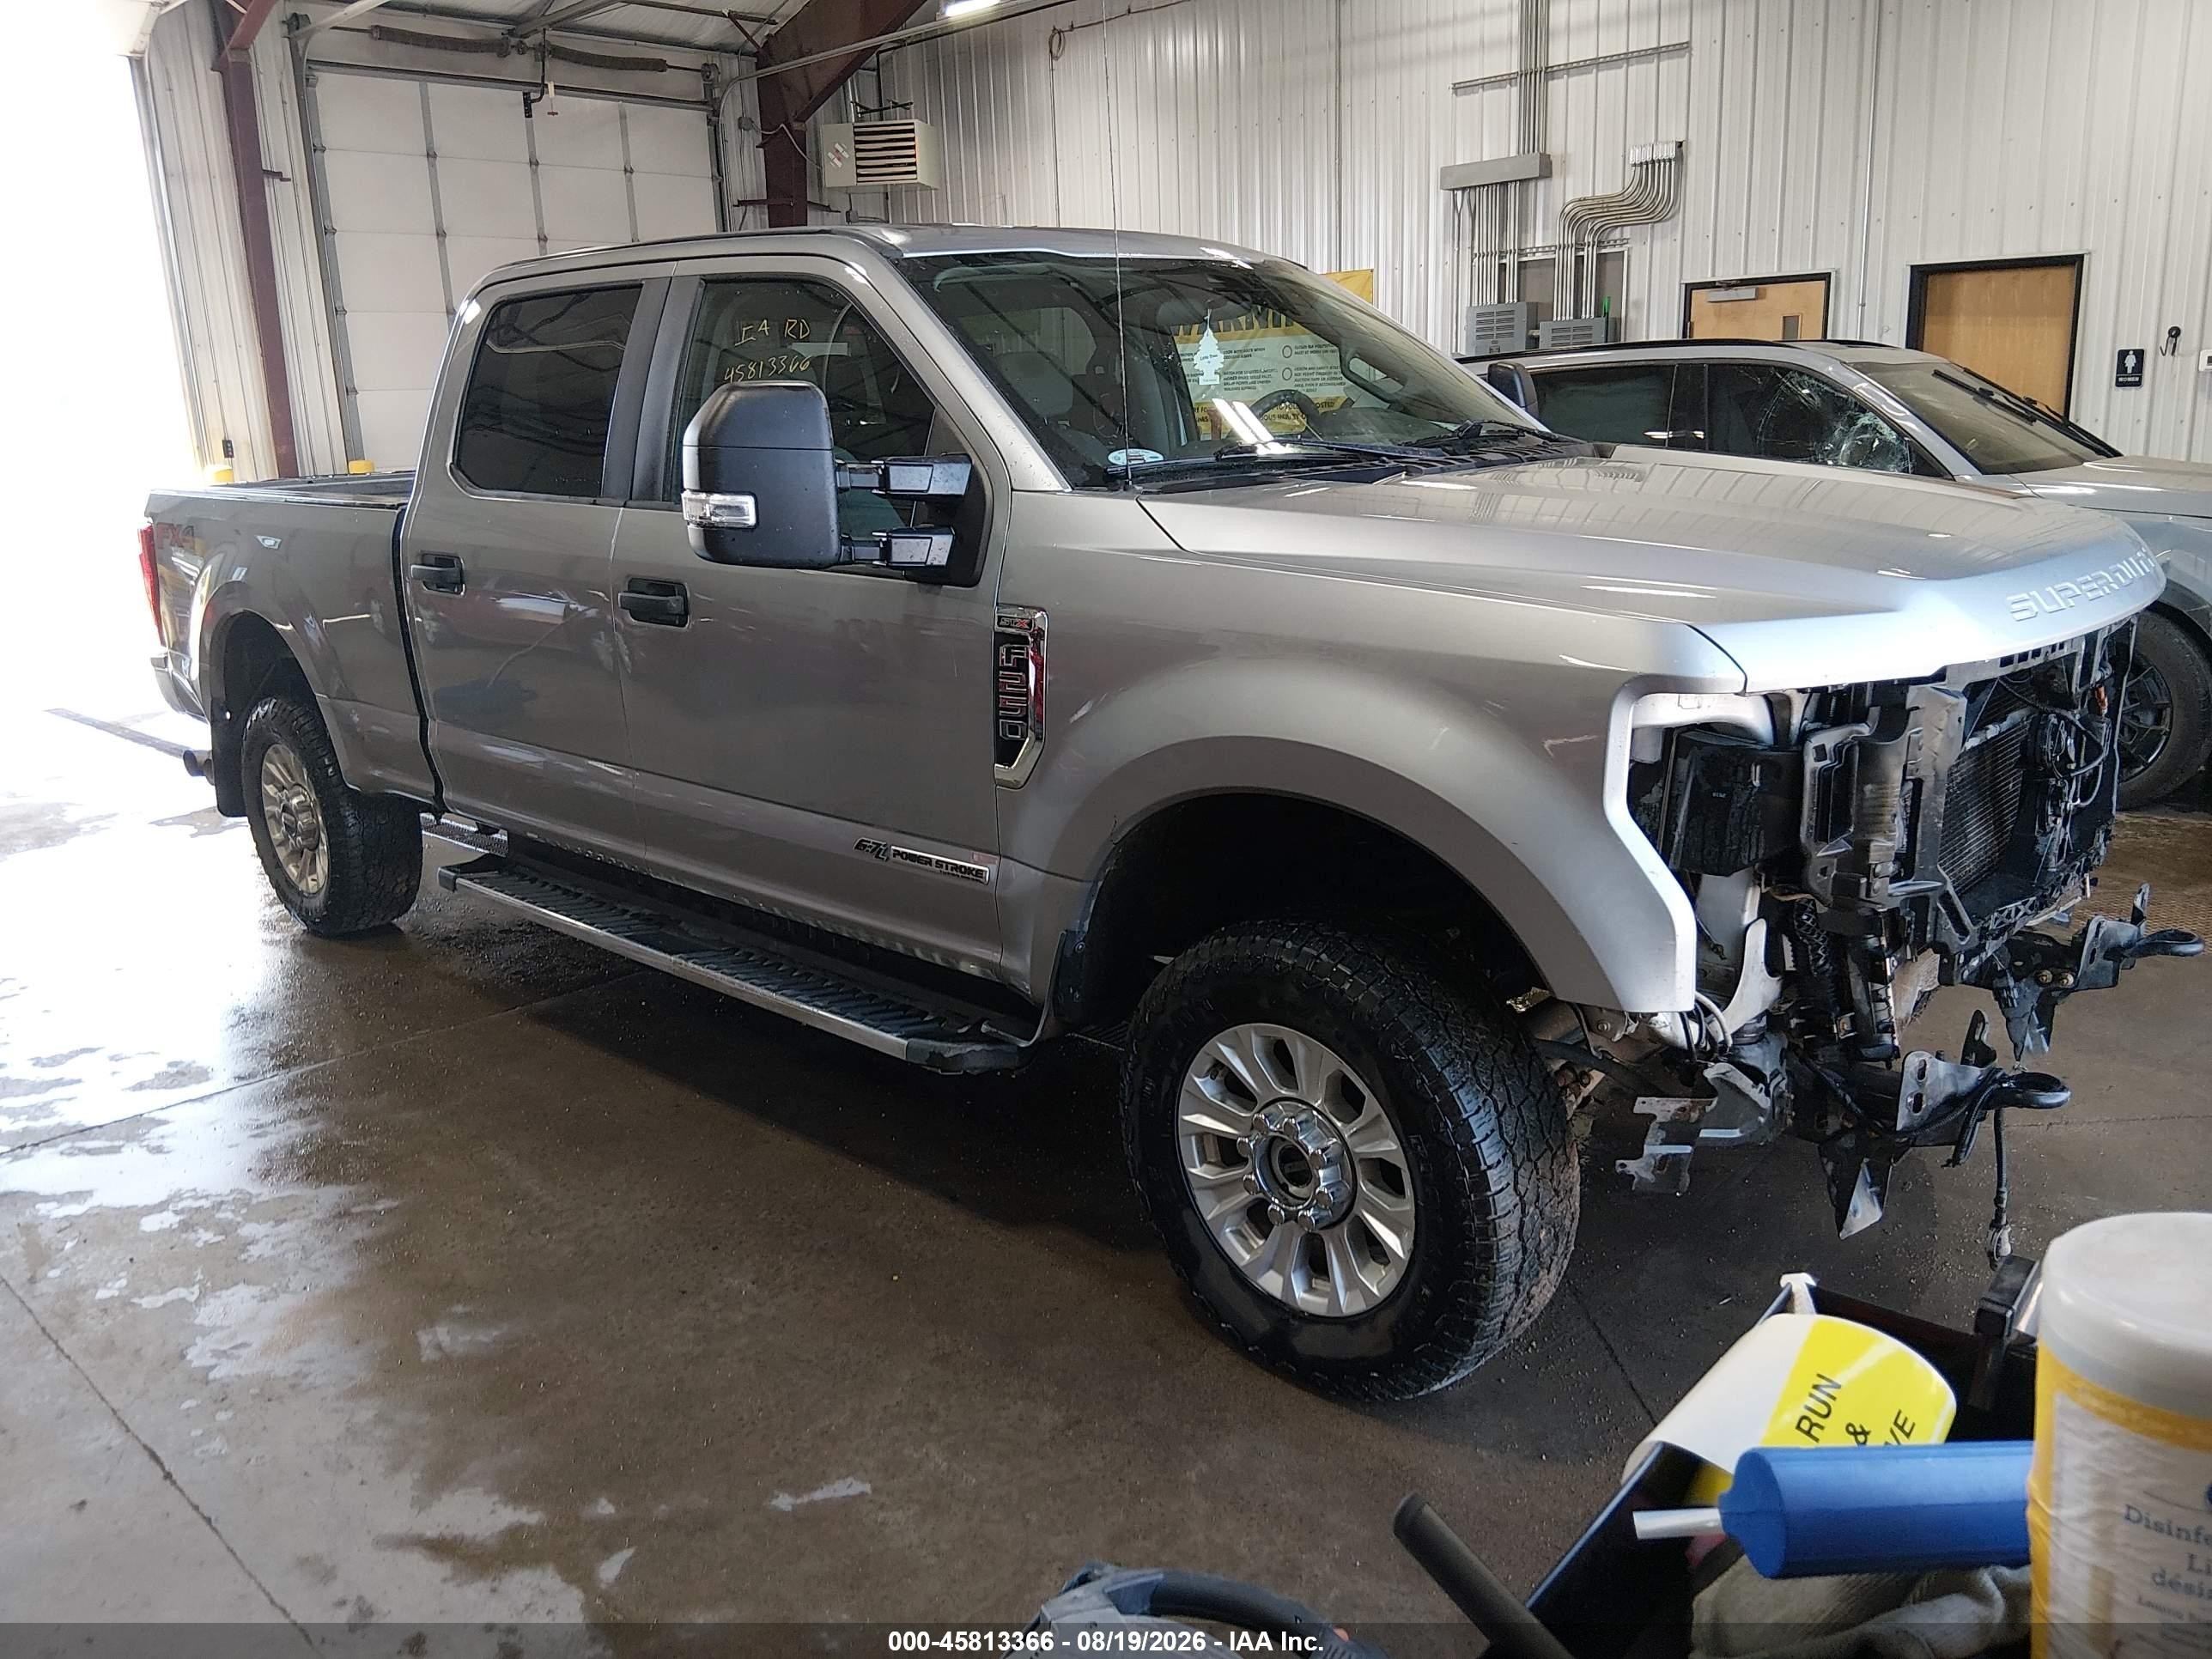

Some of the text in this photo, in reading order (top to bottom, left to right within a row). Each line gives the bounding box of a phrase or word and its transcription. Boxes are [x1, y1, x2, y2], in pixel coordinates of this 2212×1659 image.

[2006, 570, 2120, 622] SUPER
[1000, 617, 1030, 629] STX
[892, 848, 933, 867] POWER
[934, 860, 984, 879] STROKE
[1795, 1373, 1842, 1443] RUN
